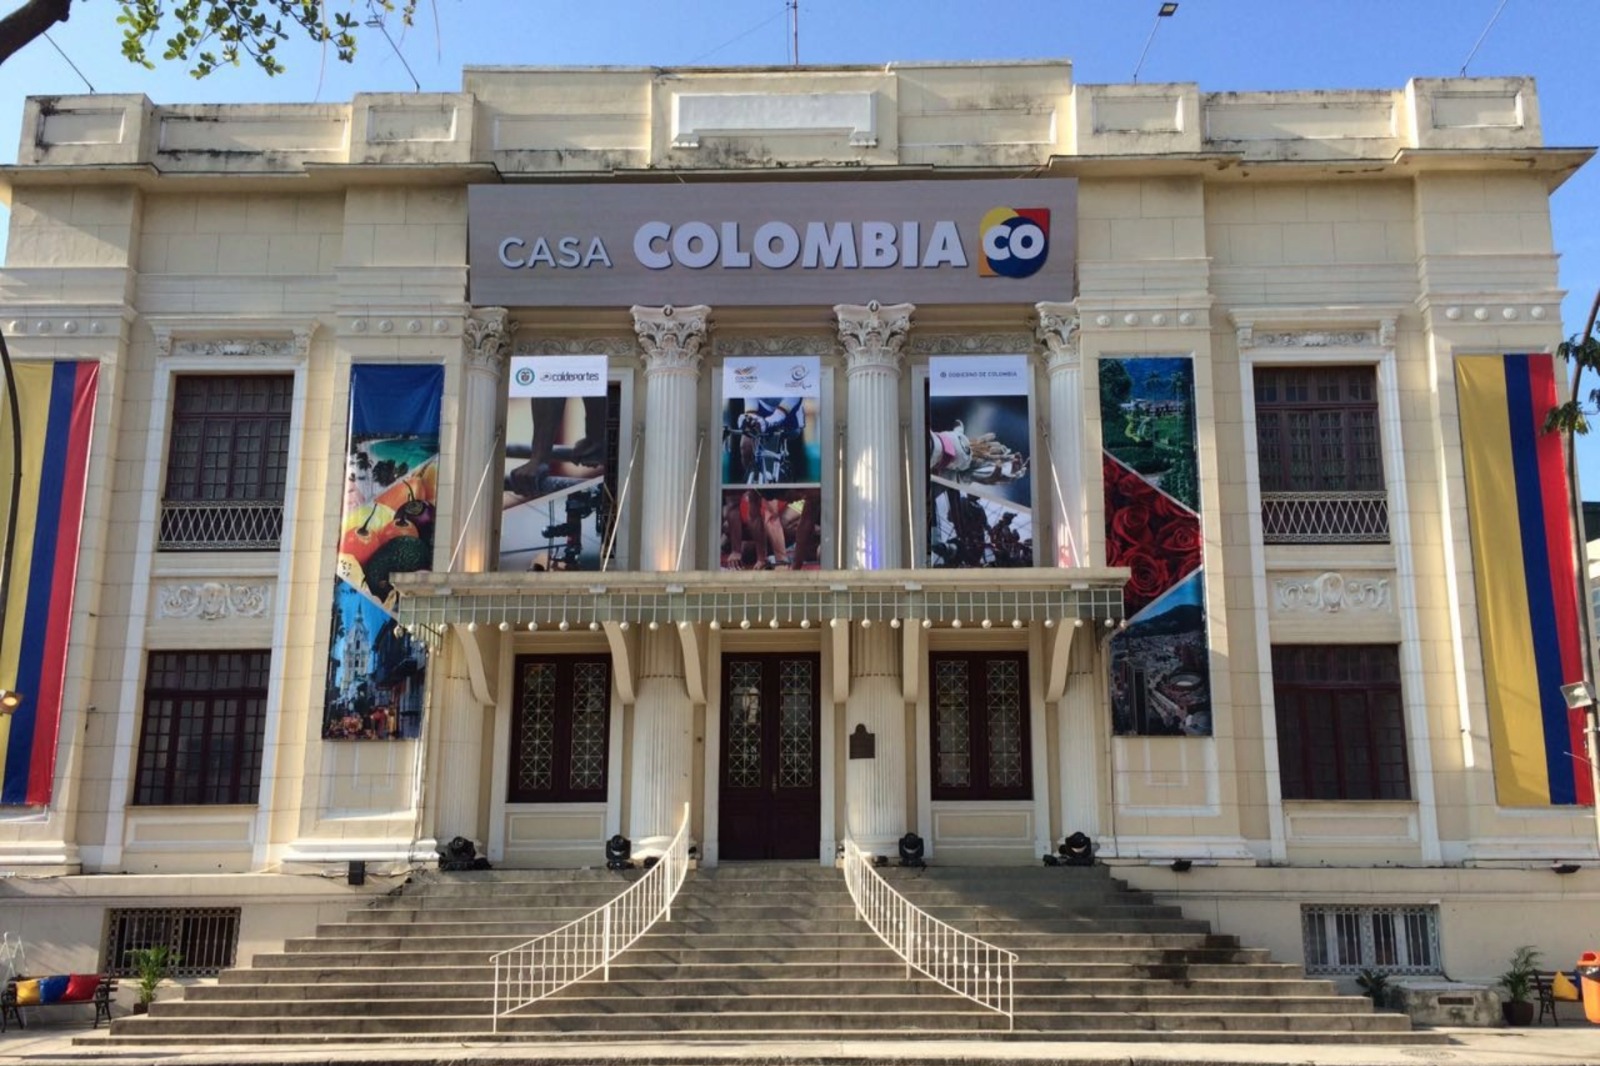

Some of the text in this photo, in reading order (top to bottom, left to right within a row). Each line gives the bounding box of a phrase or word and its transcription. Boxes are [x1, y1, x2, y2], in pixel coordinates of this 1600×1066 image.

[499, 220, 1046, 269] CASA COLOMBIA CO
[551, 371, 600, 382] coldeportes
[987, 370, 1018, 378] COLOMBIA
